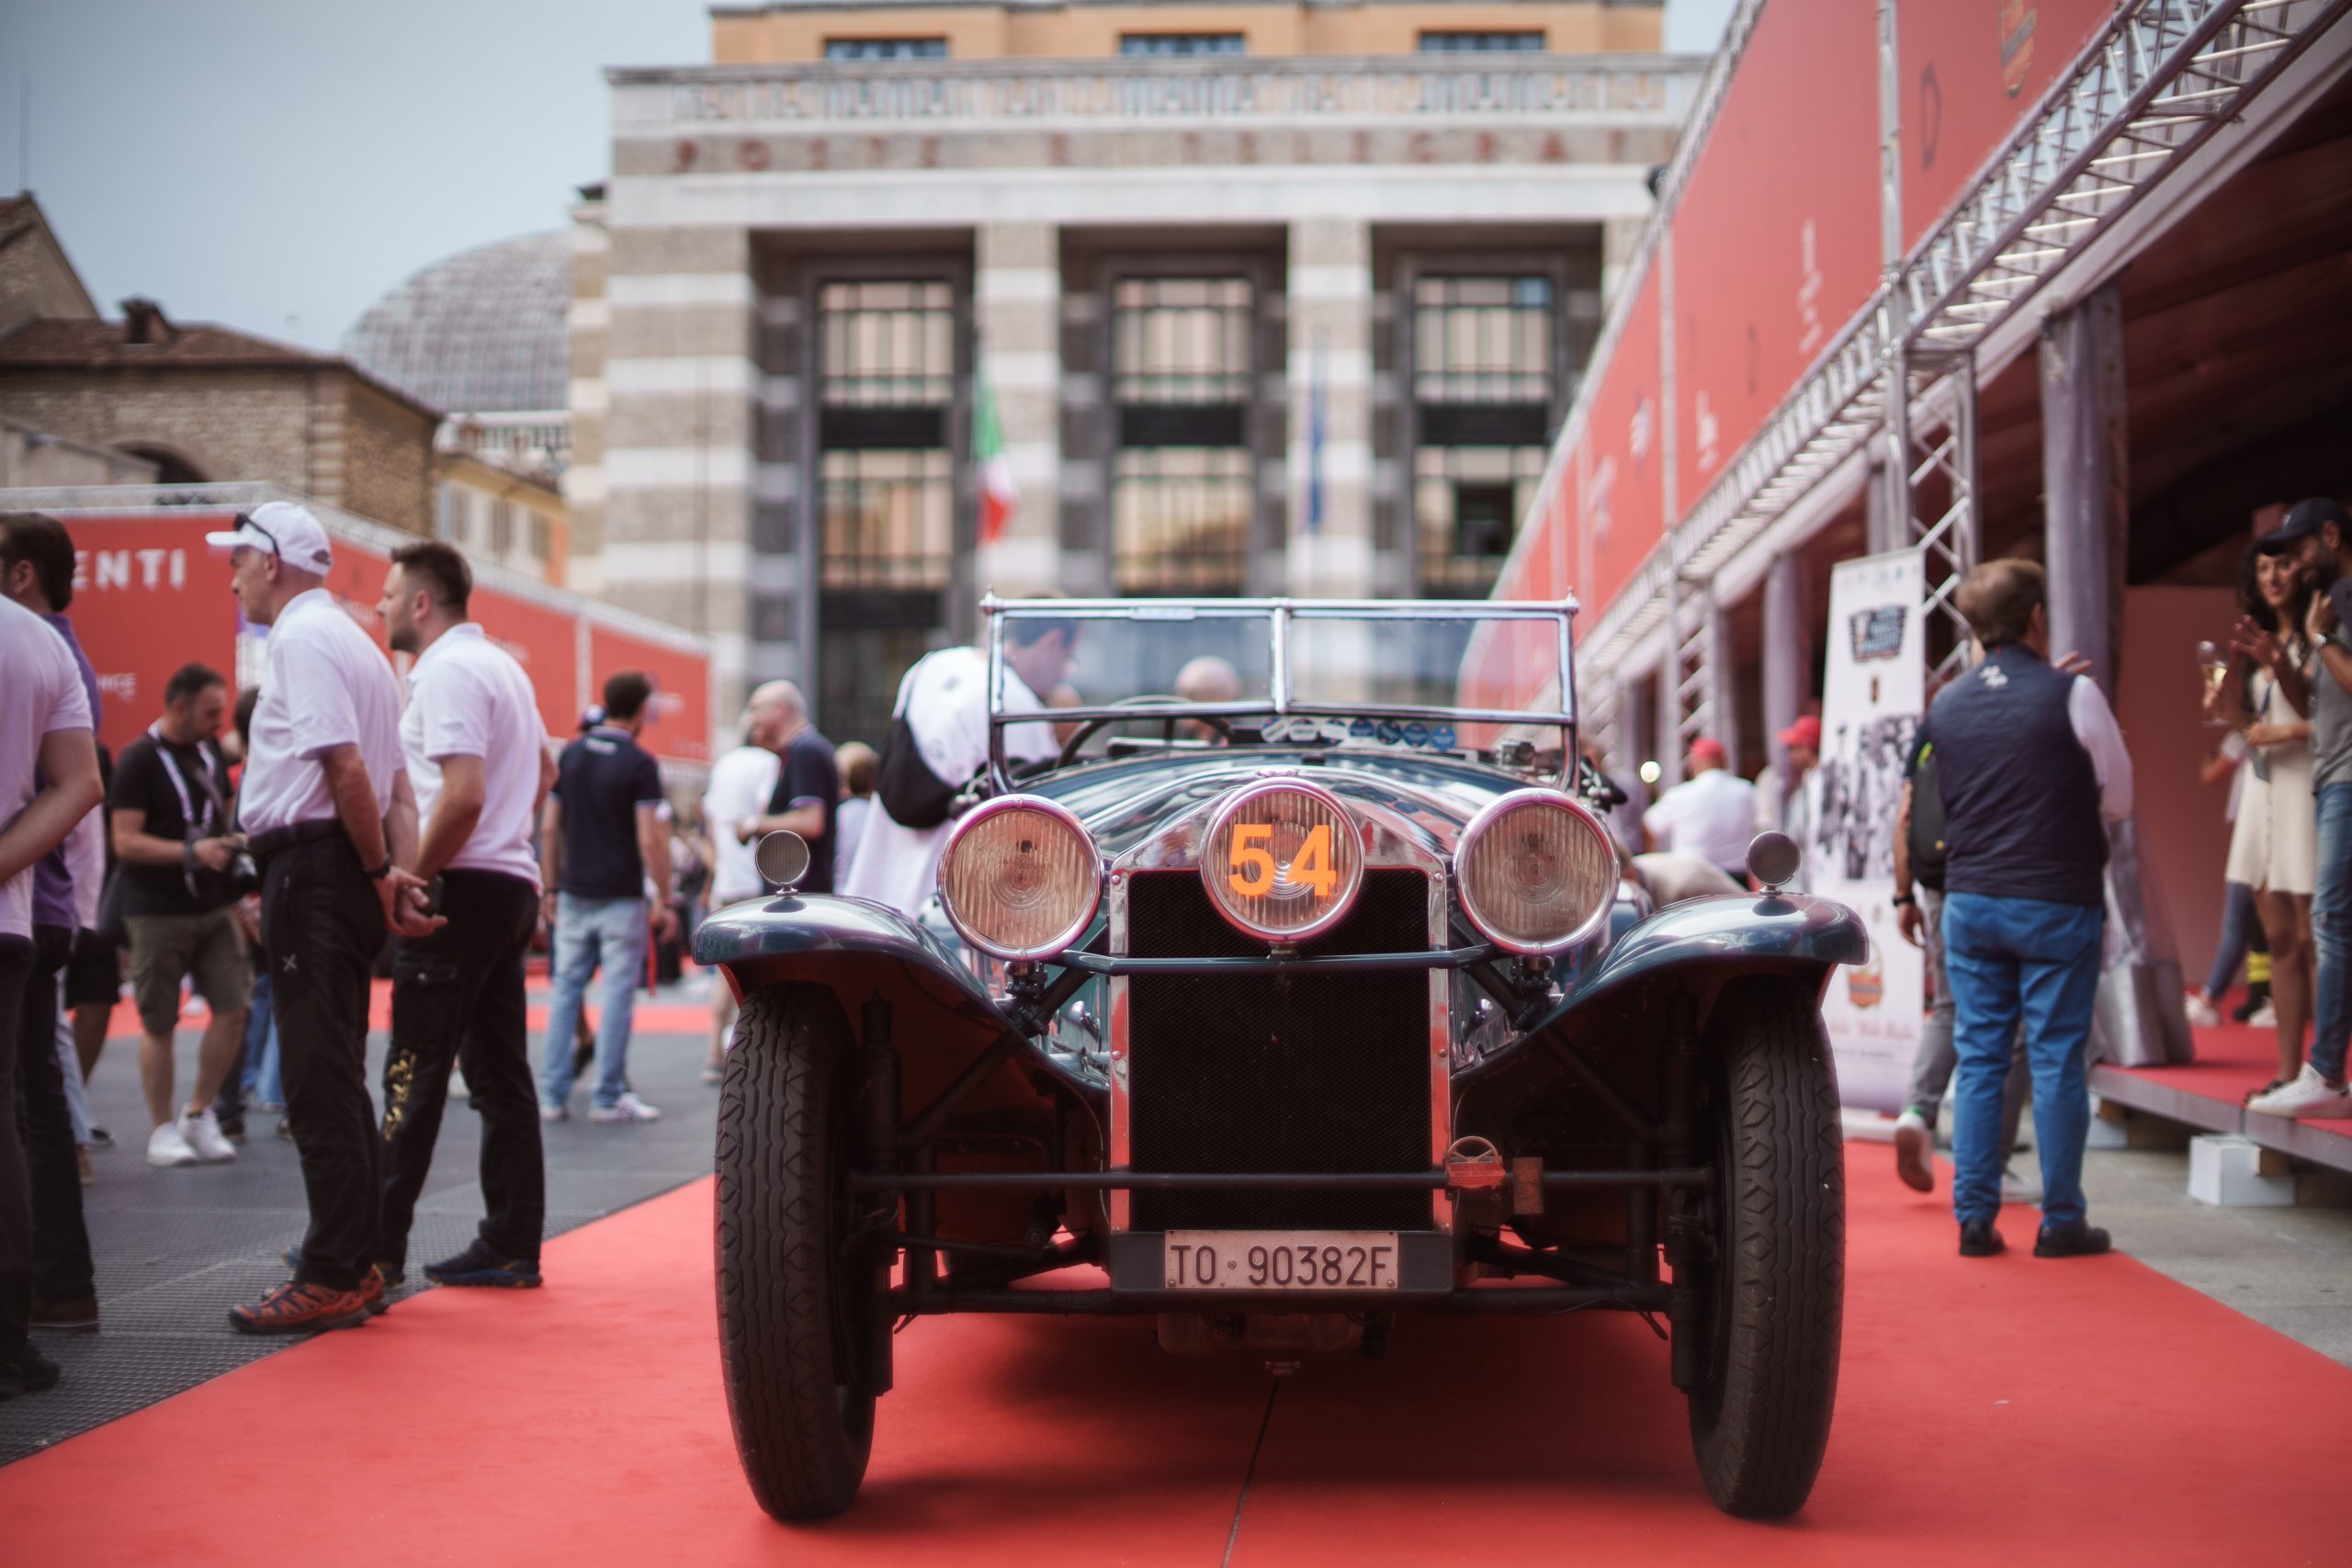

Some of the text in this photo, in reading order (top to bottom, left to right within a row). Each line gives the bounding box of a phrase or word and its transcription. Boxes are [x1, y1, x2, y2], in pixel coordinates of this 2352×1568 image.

[1228, 823, 1337, 897] 54
[1170, 1245, 1393, 1286] TO 90382F
